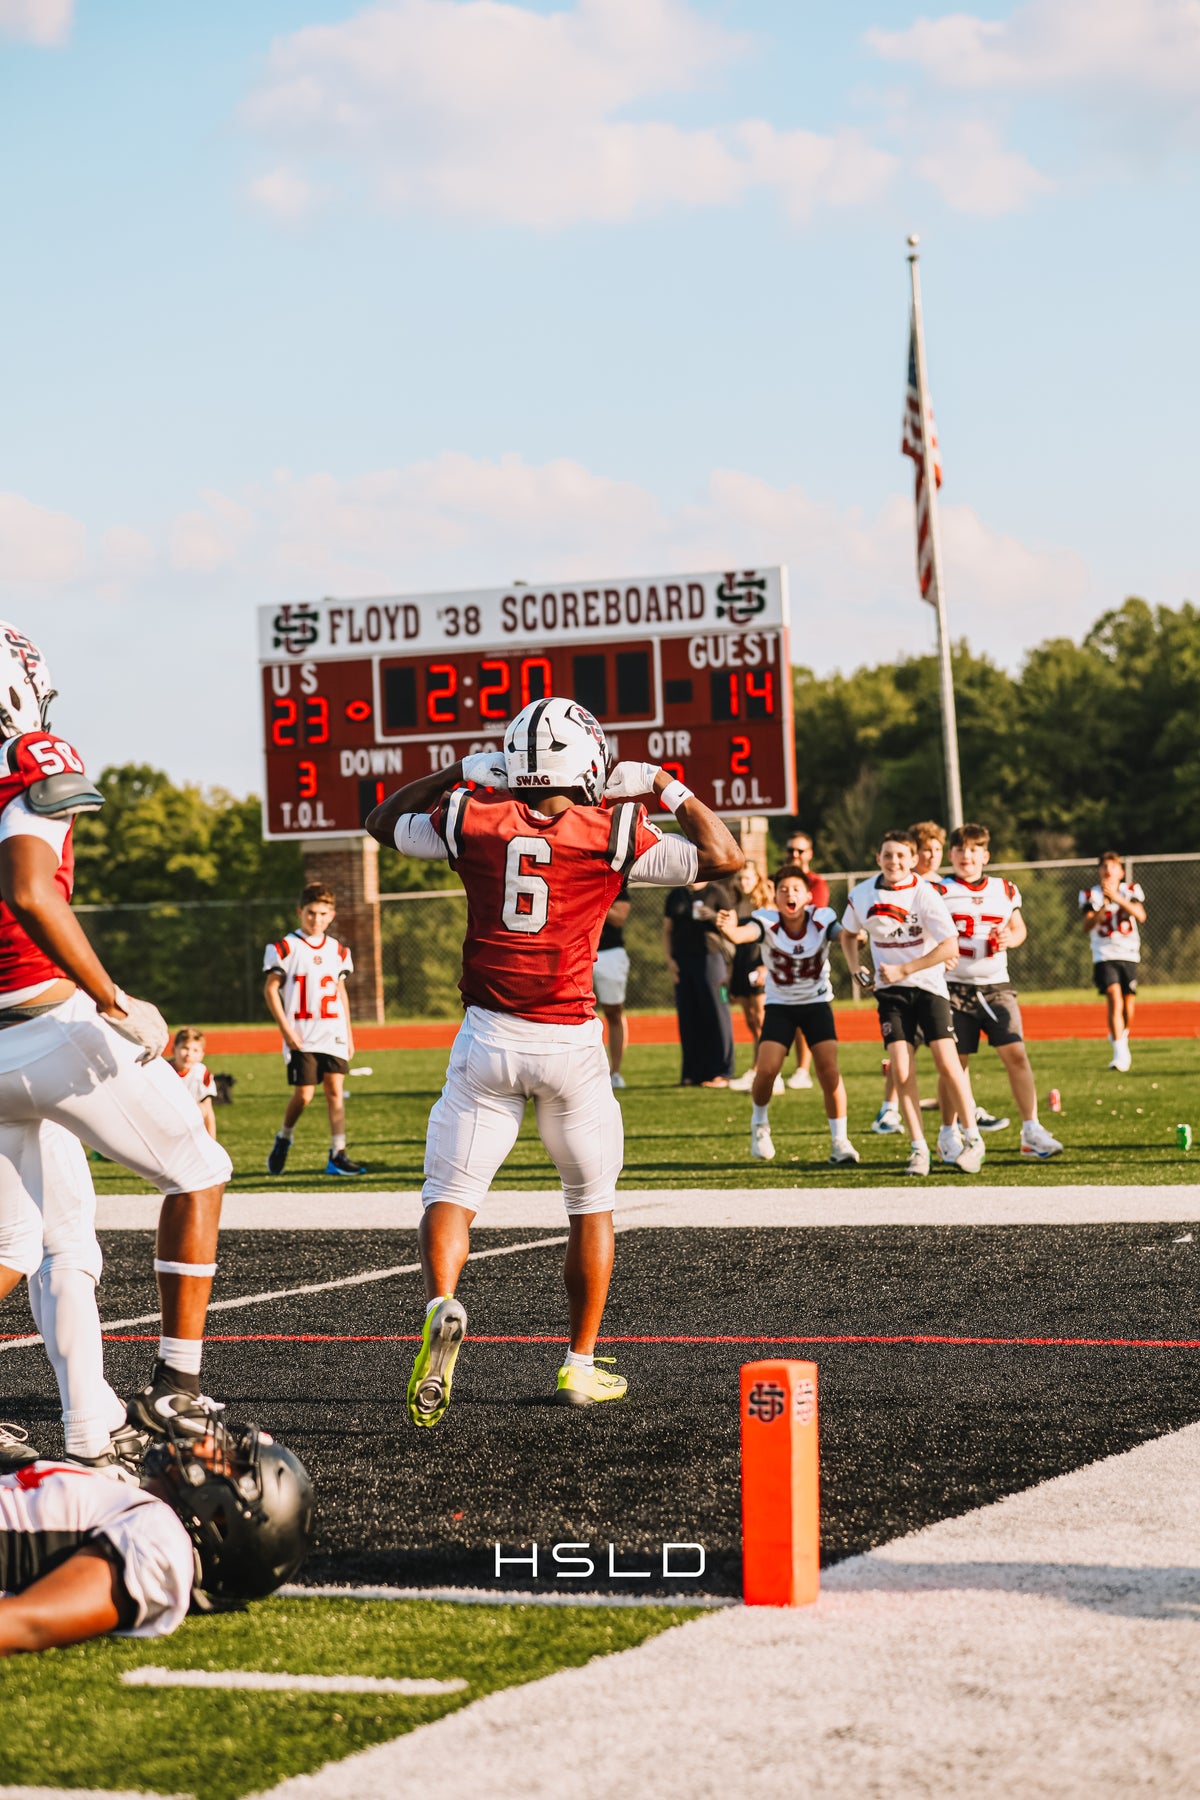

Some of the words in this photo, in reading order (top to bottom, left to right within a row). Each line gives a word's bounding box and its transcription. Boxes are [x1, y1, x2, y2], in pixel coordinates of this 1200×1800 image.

[328, 604, 420, 645] FLOYD
[501, 582, 706, 633] SCOREBOARD
[688, 633, 778, 669] GUEST
[426, 657, 552, 723] 2:20
[729, 671, 774, 716] 14
[272, 697, 329, 746] 23
[340, 748, 403, 778] DOWN
[427, 745, 456, 771] TO
[731, 736, 751, 775] 2
[298, 761, 318, 799] 3
[516, 775, 551, 786] SWAG
[712, 778, 772, 807] T.O.L.
[280, 802, 335, 829] T.O.L.
[501, 835, 552, 935] 6
[293, 974, 339, 1020] 12
